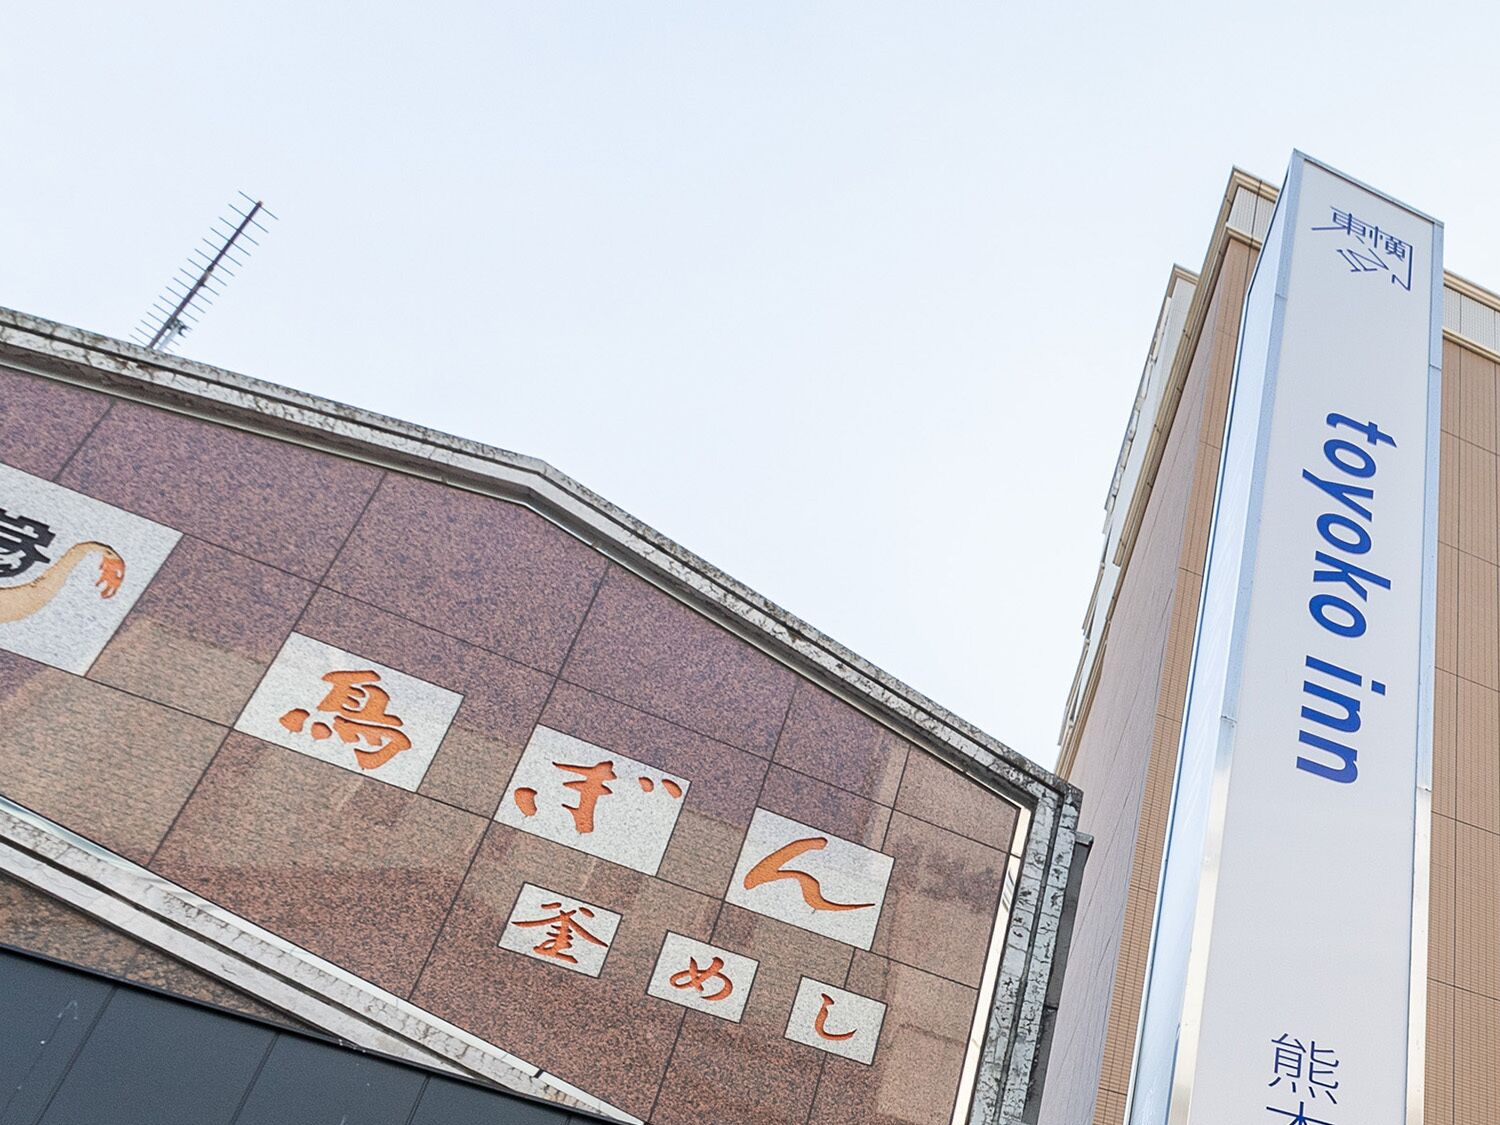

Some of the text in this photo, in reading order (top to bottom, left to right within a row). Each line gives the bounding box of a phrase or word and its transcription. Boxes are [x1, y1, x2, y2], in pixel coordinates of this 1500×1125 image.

[1295, 411, 1398, 785] toyoko inn
[511, 902, 857, 1041] 釜めし
